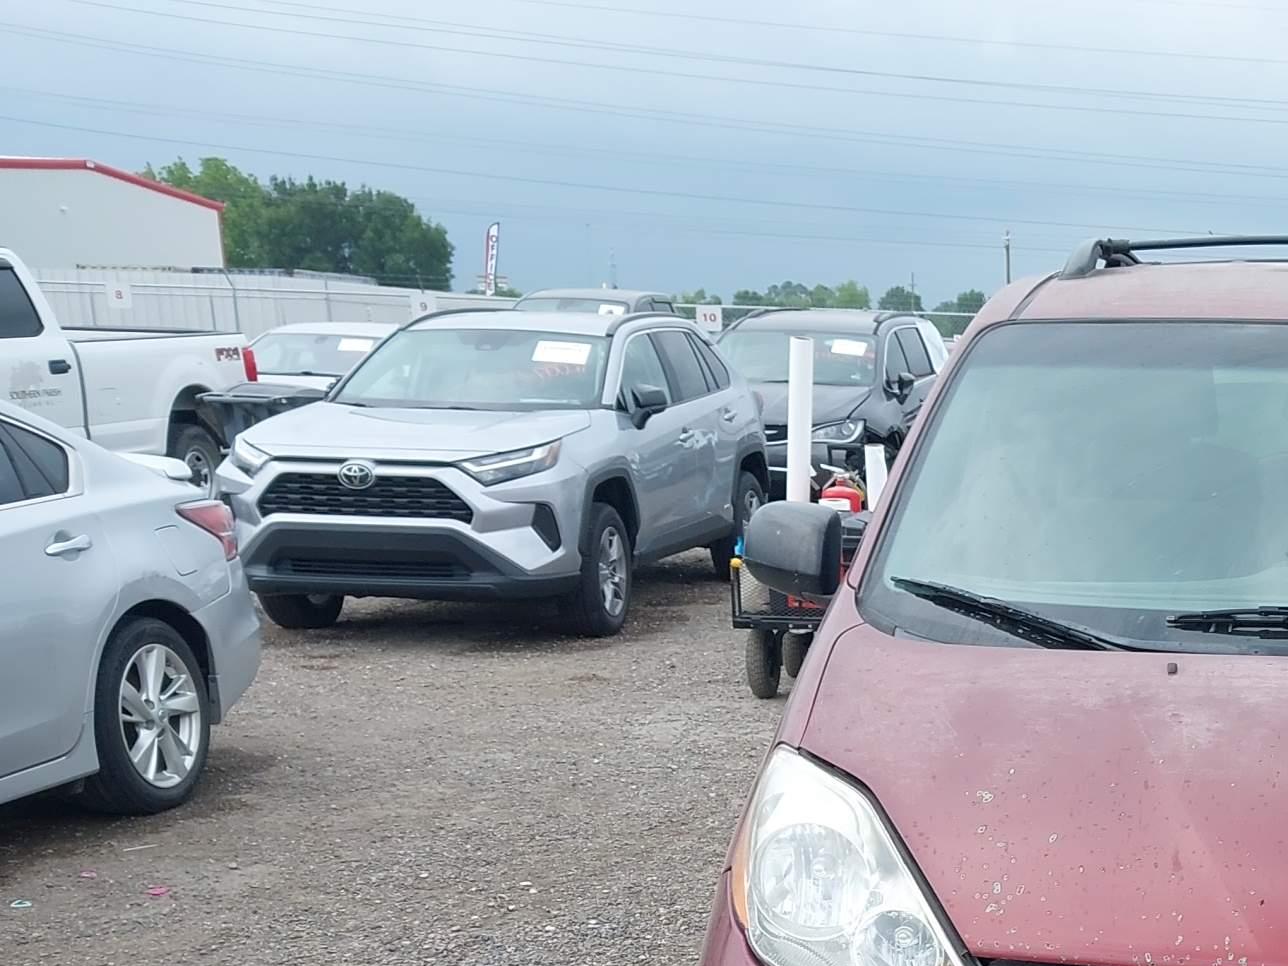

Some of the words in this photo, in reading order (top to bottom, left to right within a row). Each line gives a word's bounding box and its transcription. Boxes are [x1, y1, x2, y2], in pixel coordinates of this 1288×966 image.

[488, 234, 498, 291] OFFICE
[420, 302, 428, 312] 9
[703, 312, 717, 322] 10
[215, 346, 241, 361] FX4
